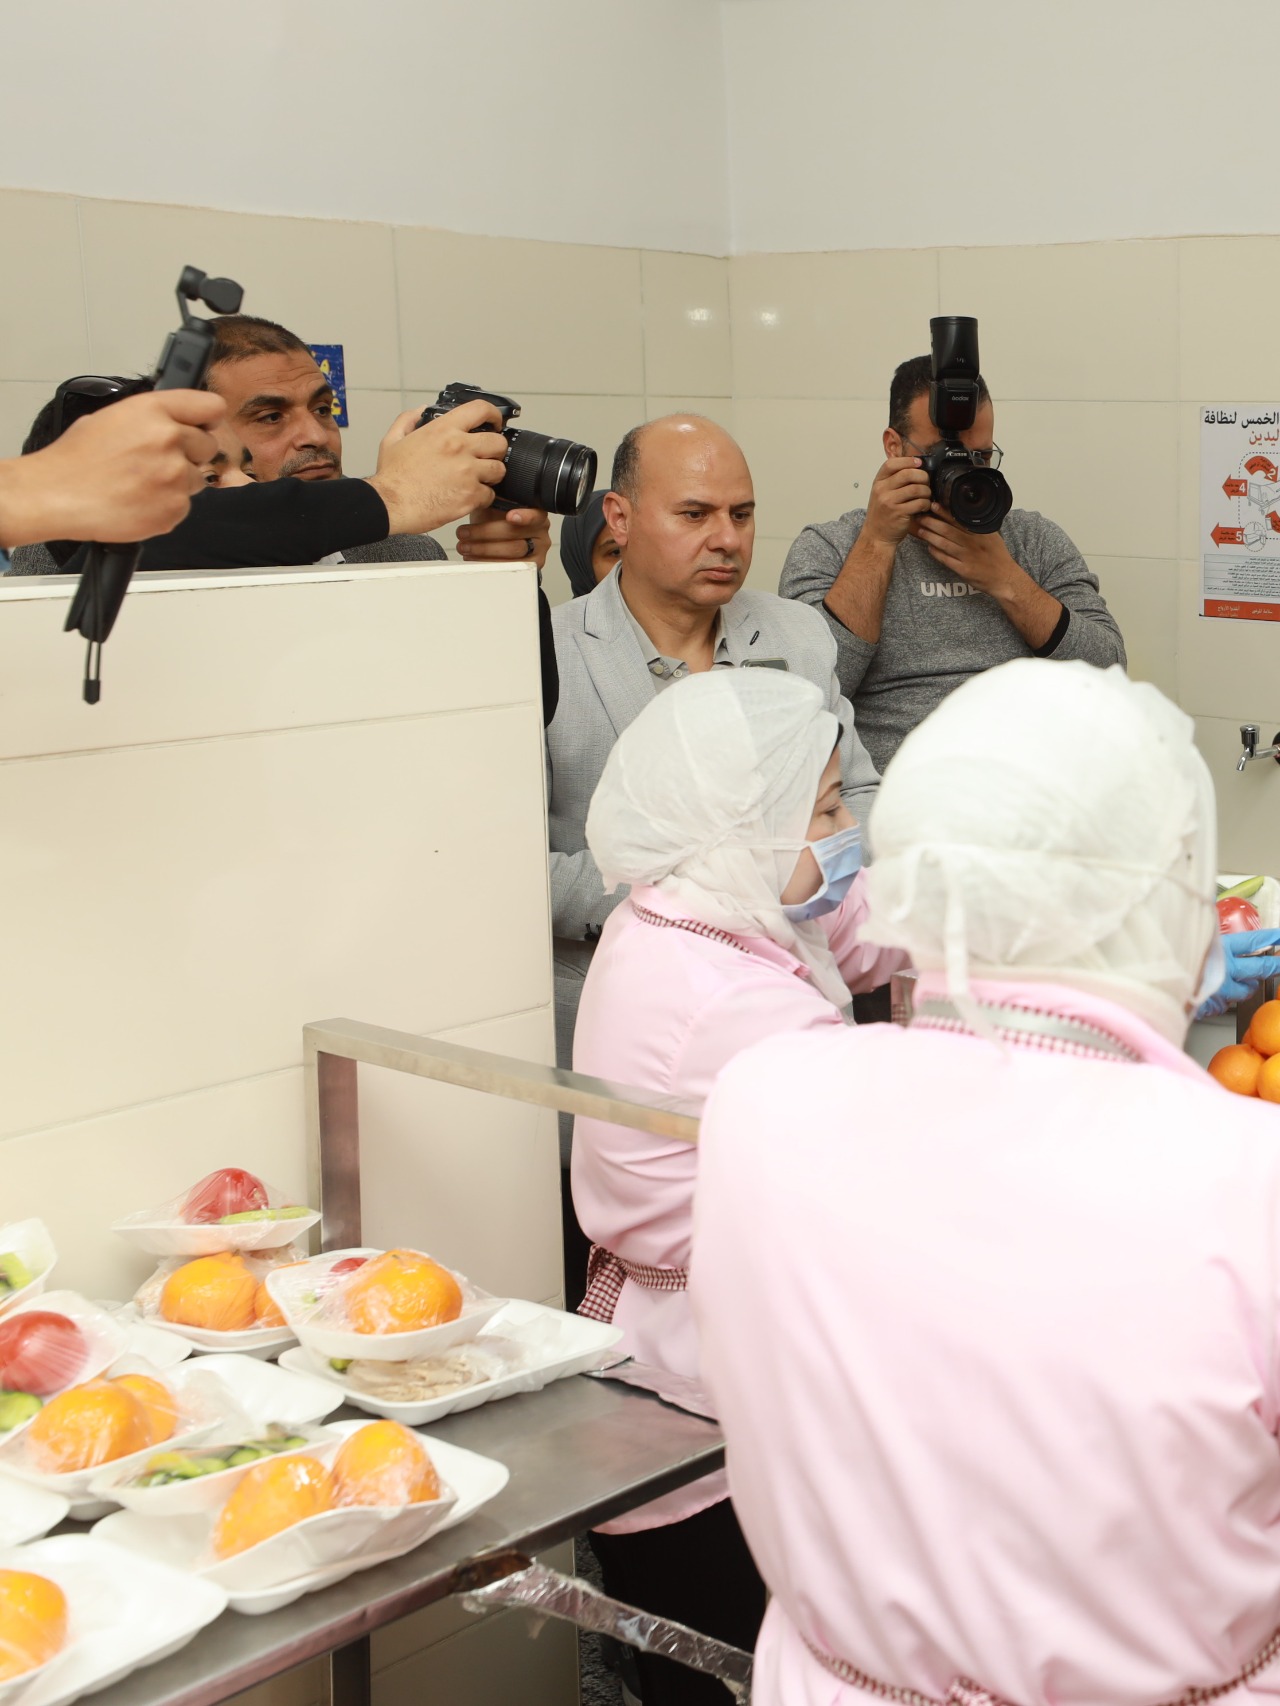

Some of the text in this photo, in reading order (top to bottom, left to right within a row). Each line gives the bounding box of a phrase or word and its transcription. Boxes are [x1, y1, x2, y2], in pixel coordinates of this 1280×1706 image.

[1204, 410, 1237, 424] لنظافة
[1241, 411, 1280, 429] الخمس
[1267, 469, 1276, 480] 2
[1239, 482, 1246, 493] 4
[1236, 531, 1243, 542] 5
